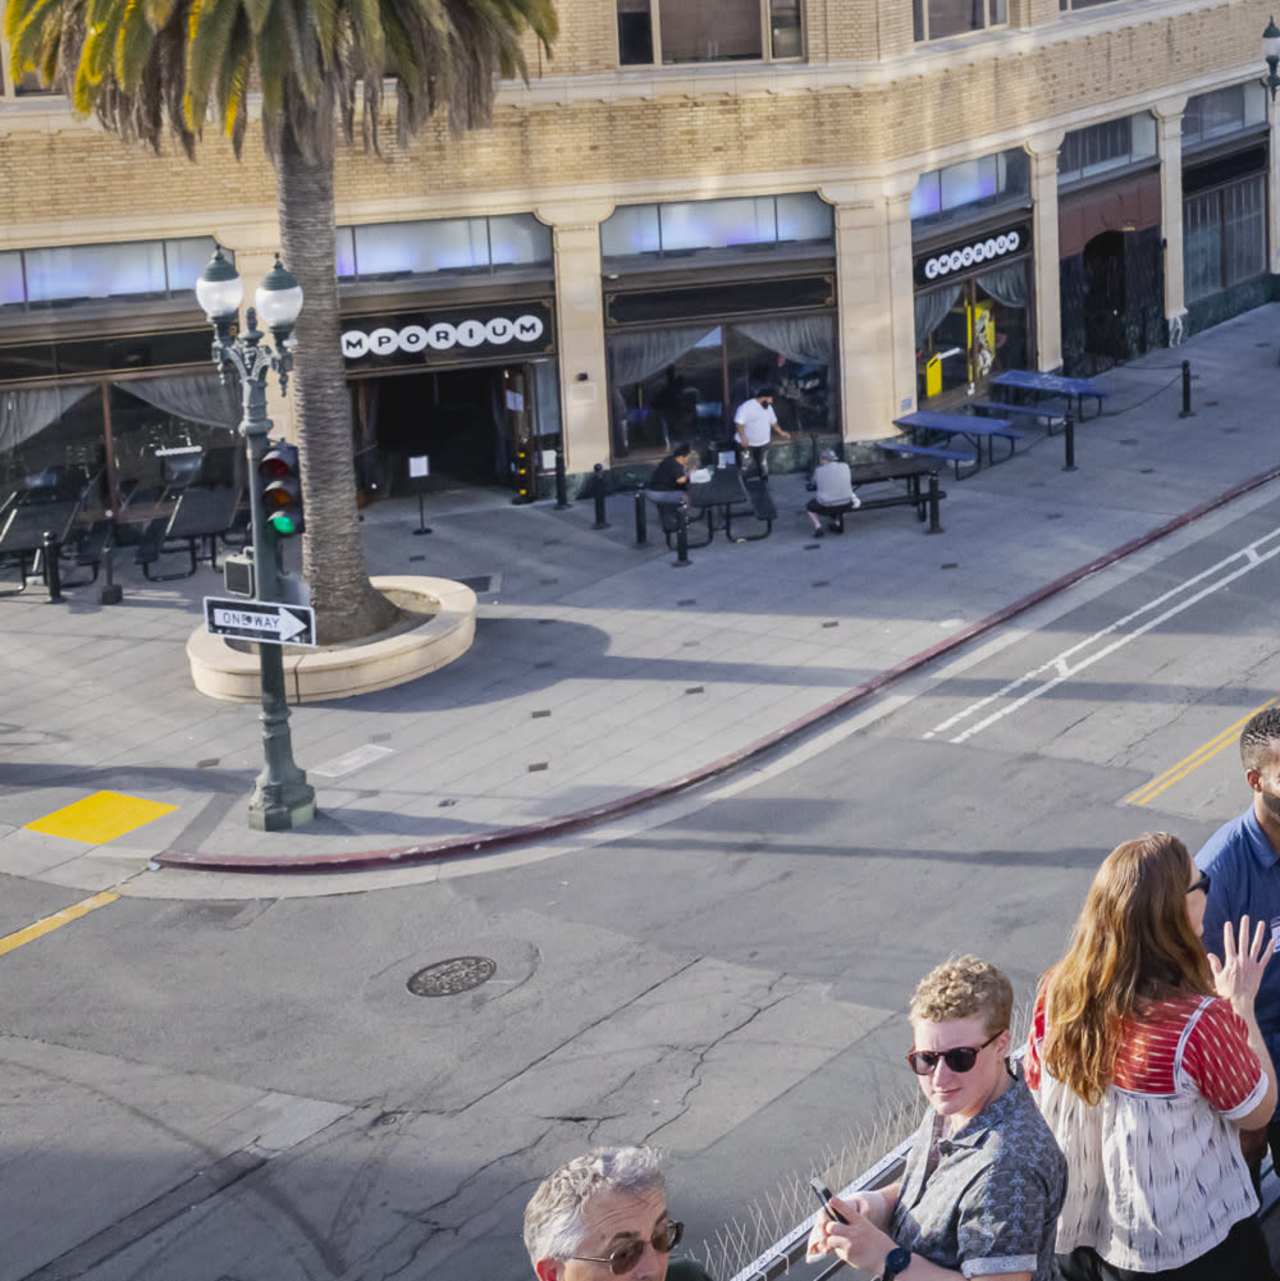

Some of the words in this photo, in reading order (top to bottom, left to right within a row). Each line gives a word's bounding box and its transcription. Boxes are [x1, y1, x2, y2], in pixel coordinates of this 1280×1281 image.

[927, 235, 1018, 275] EMPORIUM
[344, 320, 539, 353] MPORIUM
[223, 612, 249, 626] ONE
[254, 617, 279, 629] WAY
